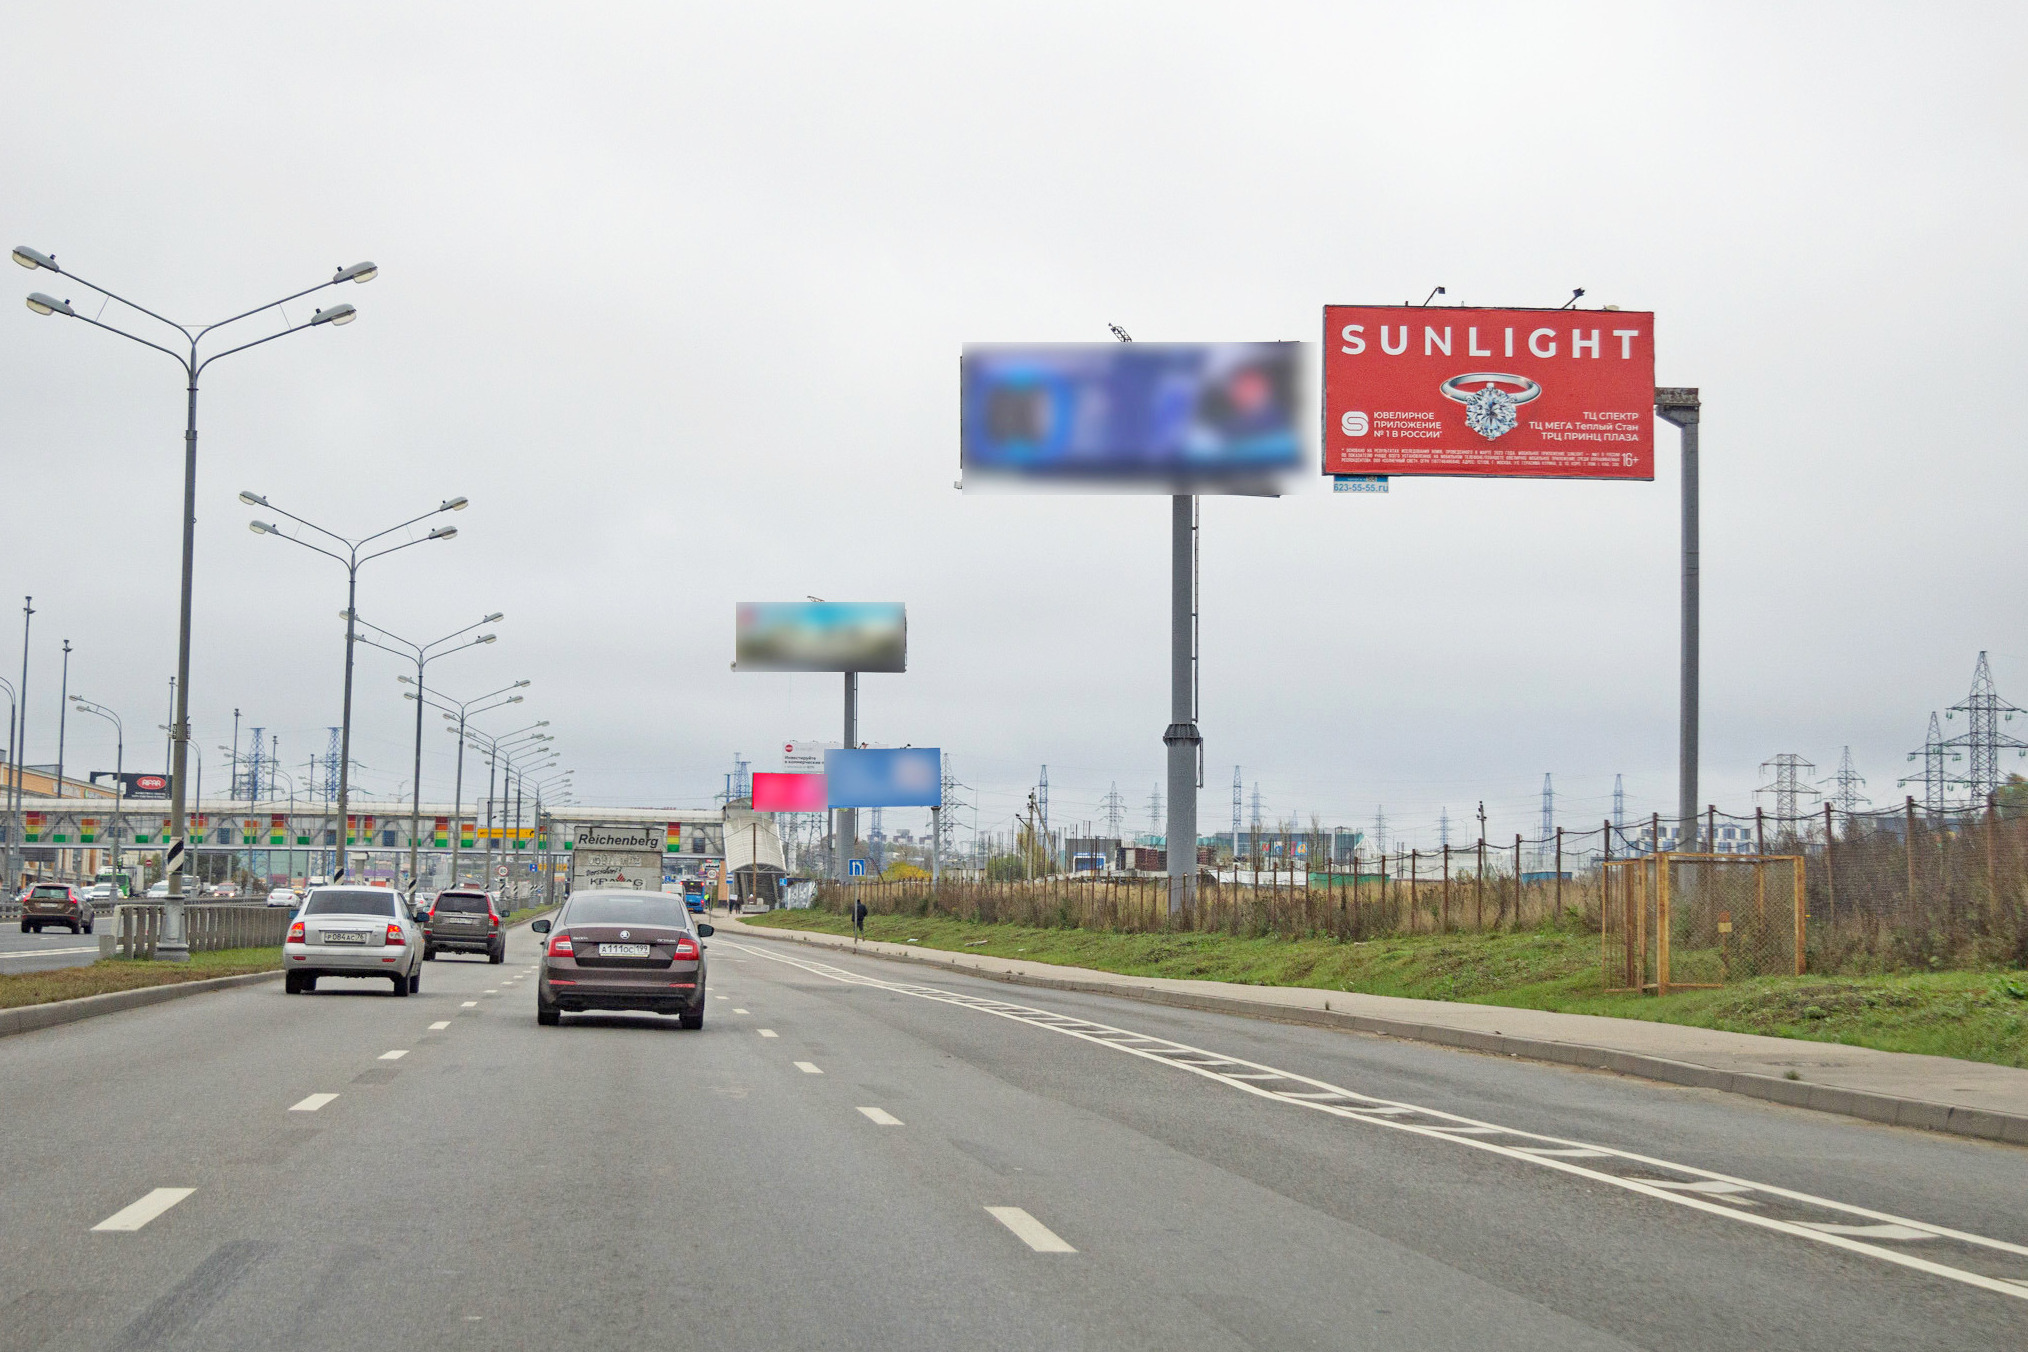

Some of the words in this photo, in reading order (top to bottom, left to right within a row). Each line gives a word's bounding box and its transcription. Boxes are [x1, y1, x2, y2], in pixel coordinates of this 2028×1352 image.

[1341, 324, 1639, 359] SUNLIGHT
[1373, 411, 1435, 420] ЮВЕЛИРНОЕ
[1582, 411, 1597, 421] ТЦ
[1598, 411, 1639, 420] СПЕКТР
[1373, 420, 1442, 429] ПРИЛОЖЕНИЕ
[1528, 421, 1543, 431] ТЦ
[1544, 421, 1573, 430] МЕГА
[1575, 421, 1613, 431] Теплый
[1614, 422, 1639, 431] Стан
[1392, 430, 1398, 438] В
[1541, 431, 1562, 442] ТРЦ
[1564, 432, 1602, 442] ПРИНЦ
[1603, 433, 1639, 441] ПЛАЗА
[1621, 452, 1640, 467] 16+
[1334, 483, 1389, 492] 623-55-55.ru
[578, 833, 659, 849] Reichenberg
